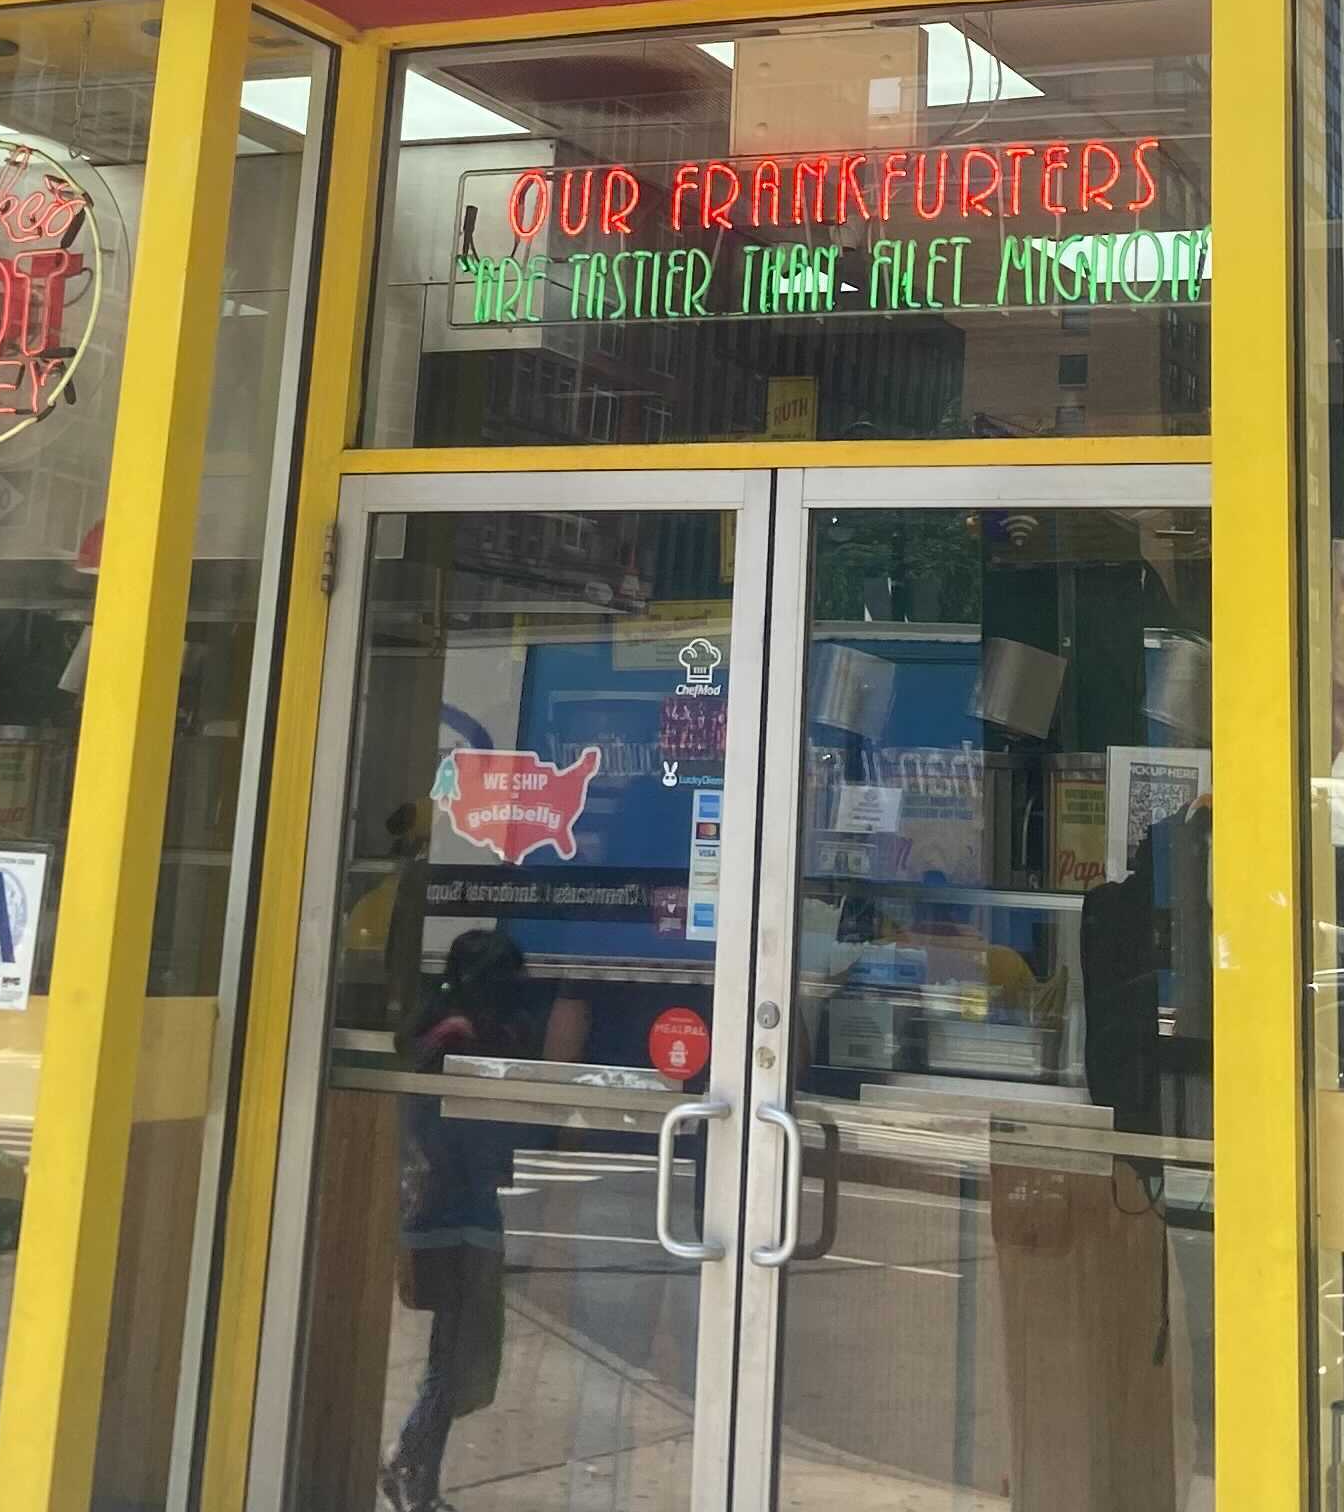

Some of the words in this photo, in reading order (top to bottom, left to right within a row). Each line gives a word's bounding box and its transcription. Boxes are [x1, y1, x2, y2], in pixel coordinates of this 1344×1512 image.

[508, 167, 640, 240] OUR
[671, 137, 1160, 231] FRANKFURTERS
[570, 246, 712, 320] TASTIER
[742, 243, 840, 316] THAN
[869, 233, 972, 310] FILET
[675, 684, 722, 699] ChefMod
[483, 772, 508, 791] WE
[512, 772, 549, 791] SHIP
[466, 803, 562, 831] goldbelly
